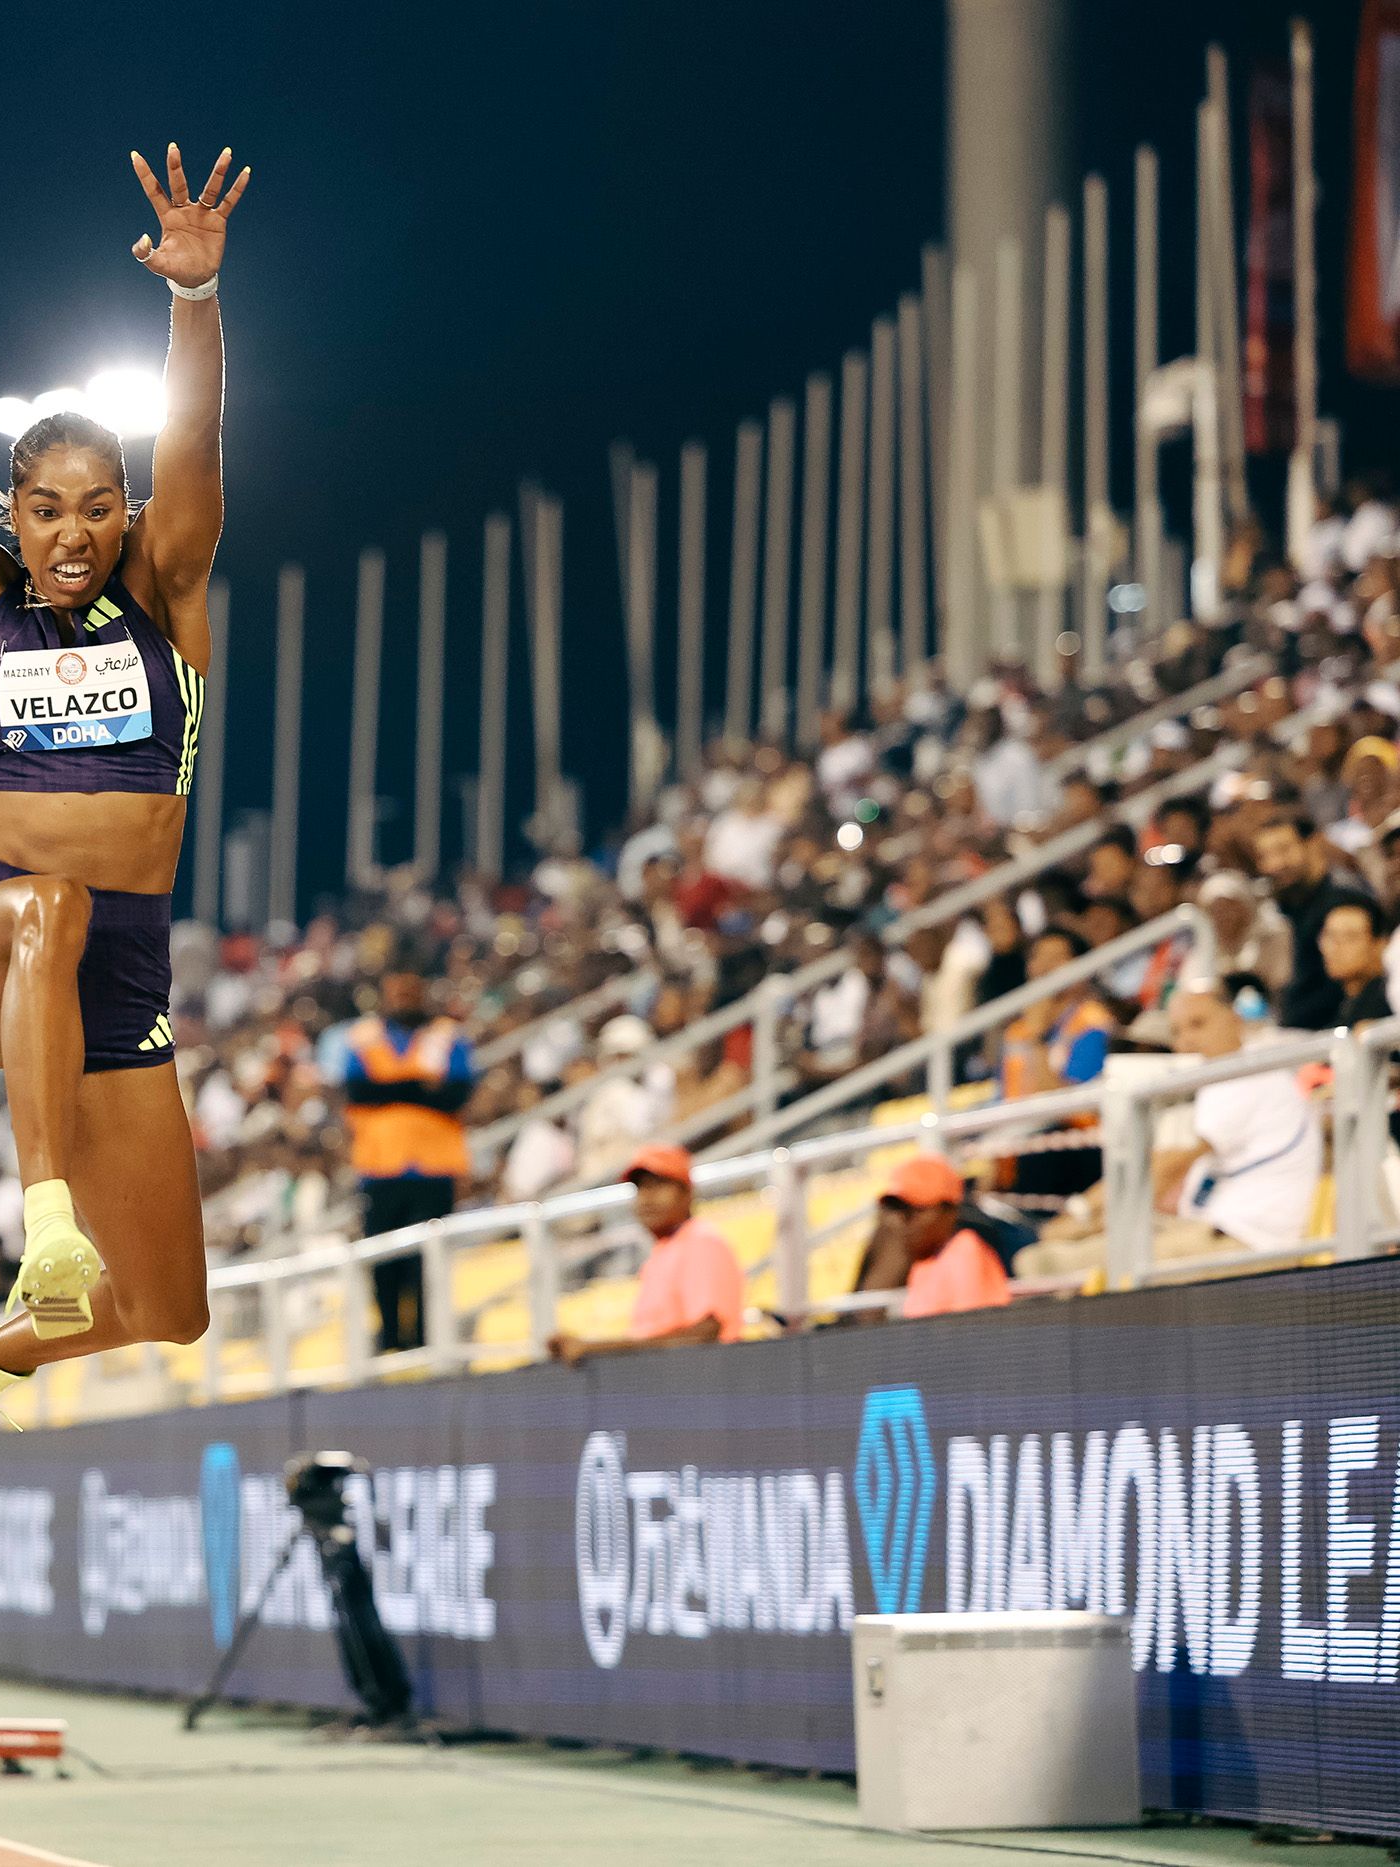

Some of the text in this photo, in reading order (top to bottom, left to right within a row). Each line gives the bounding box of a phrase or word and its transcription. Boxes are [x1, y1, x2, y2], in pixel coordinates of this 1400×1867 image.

[3, 667, 51, 678] MAZZRATY
[95, 654, 139, 675] مزرعتي
[10, 687, 138, 720] VELAZCO
[52, 724, 111, 745] DOHA
[946, 1420, 1263, 1676] DIAMOND
